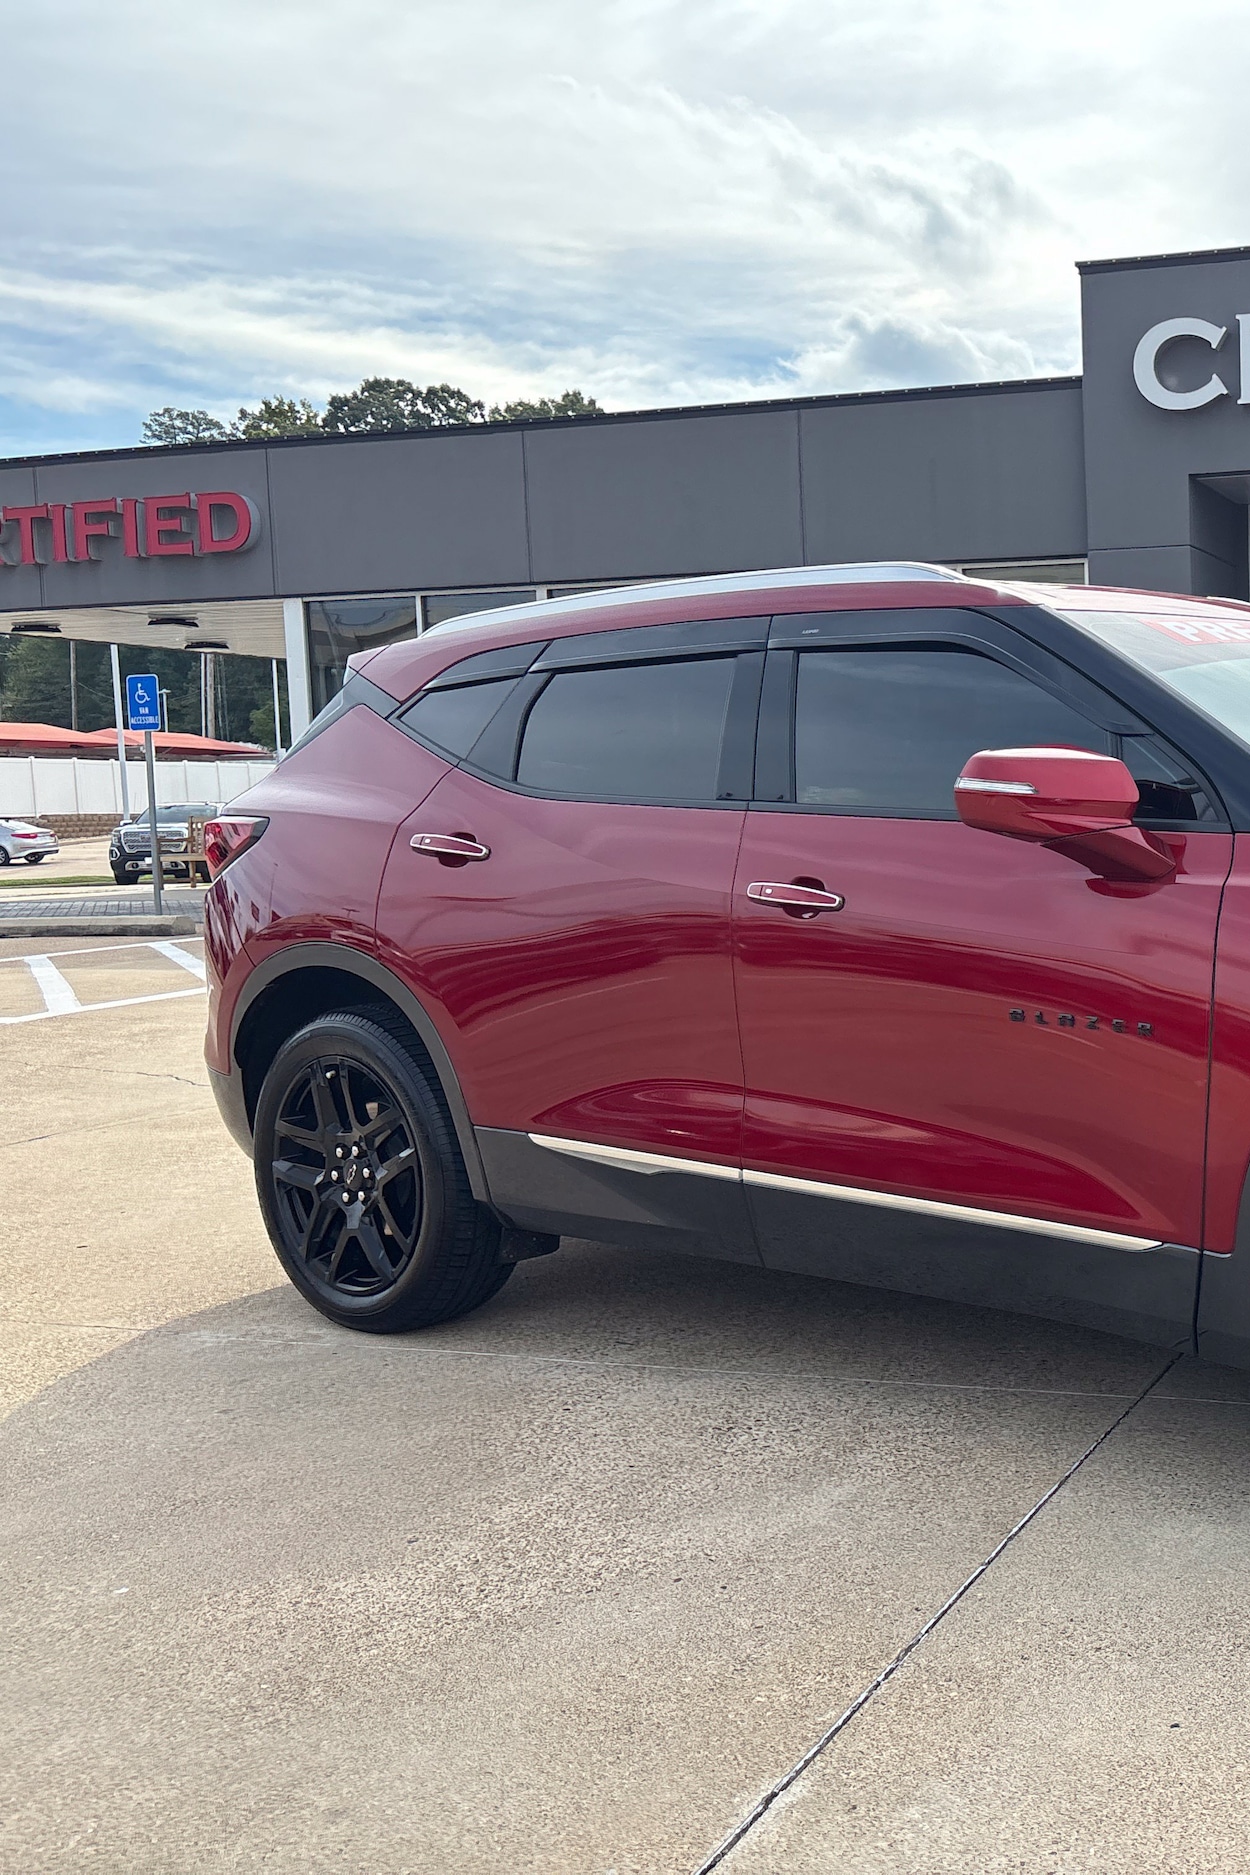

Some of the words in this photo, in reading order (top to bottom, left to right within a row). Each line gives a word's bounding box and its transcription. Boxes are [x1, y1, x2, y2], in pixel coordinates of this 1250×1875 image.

[0, 492, 252, 566] TIFIED
[131, 716, 158, 725] ACCESSIBLE
[1009, 1008, 1153, 1037] BLAZER
